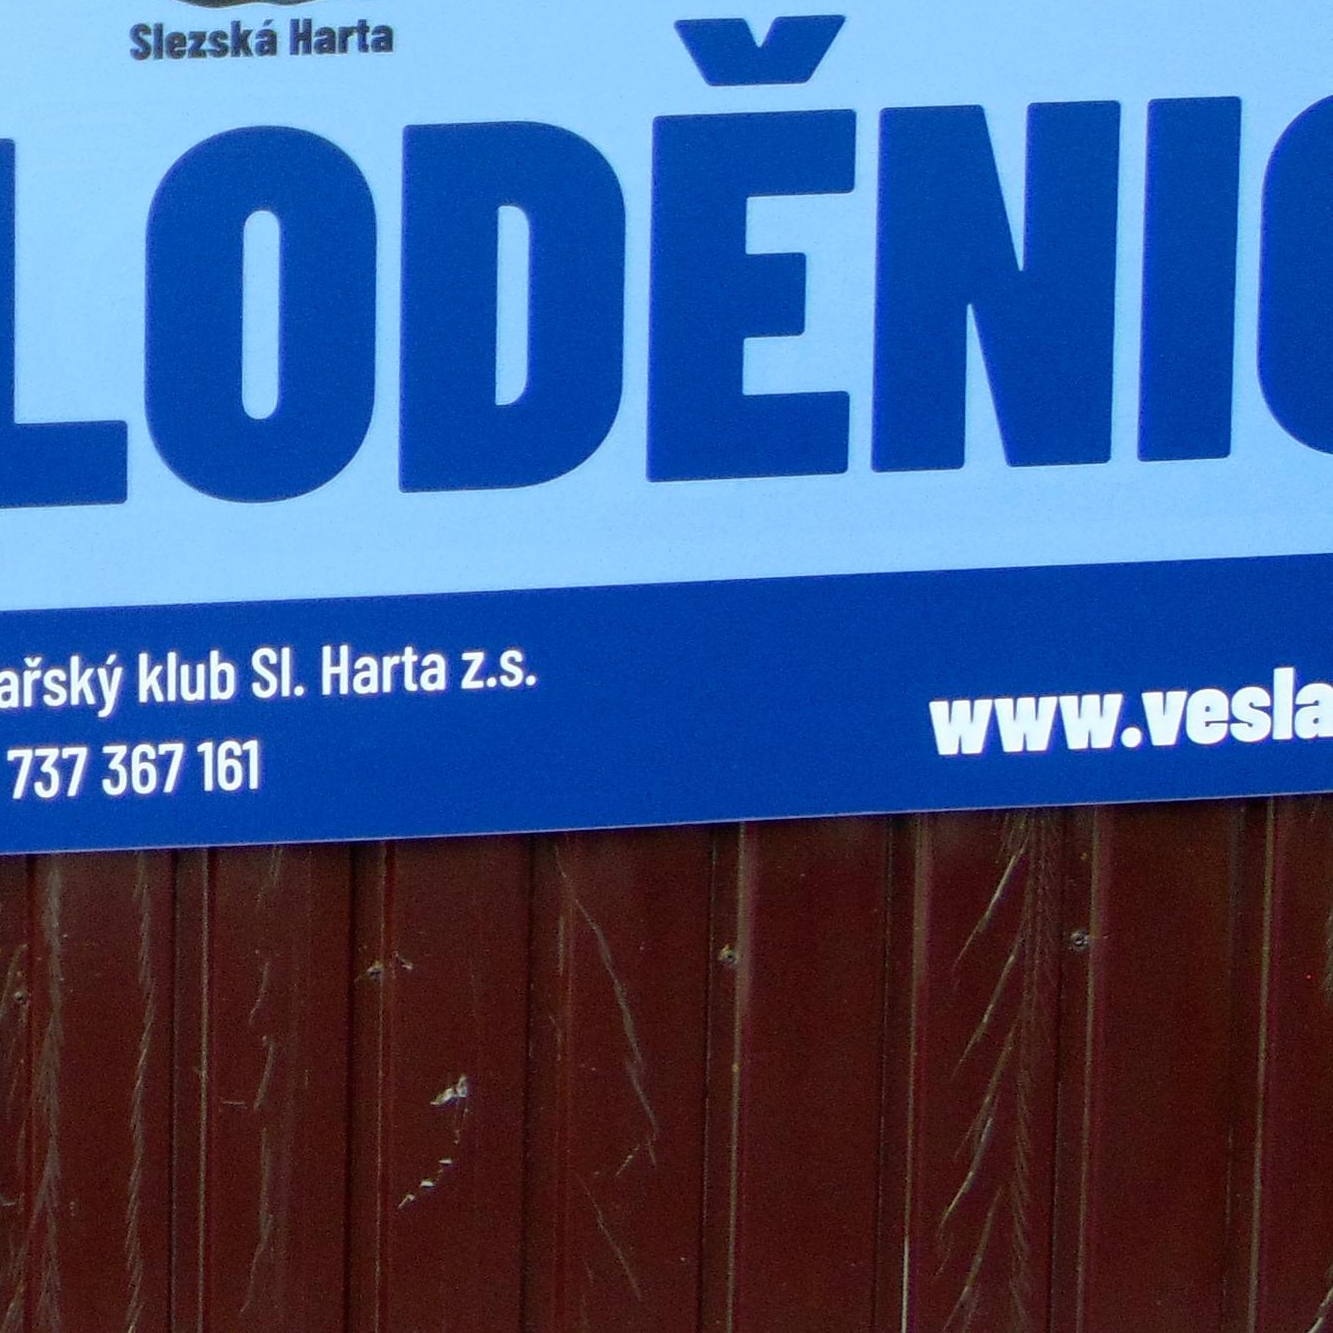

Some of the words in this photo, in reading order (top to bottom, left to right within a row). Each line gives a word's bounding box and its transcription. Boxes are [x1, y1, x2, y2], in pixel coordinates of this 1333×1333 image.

[130, 19, 277, 61] Slezská
[290, 17, 394, 56] Harta
[137, 650, 236, 704] klub
[251, 646, 305, 699] Sl.
[321, 645, 447, 696] Harta
[460, 648, 538, 690] z.s.
[7, 746, 88, 800] 737
[101, 742, 185, 797] 367
[196, 739, 261, 792] 161
